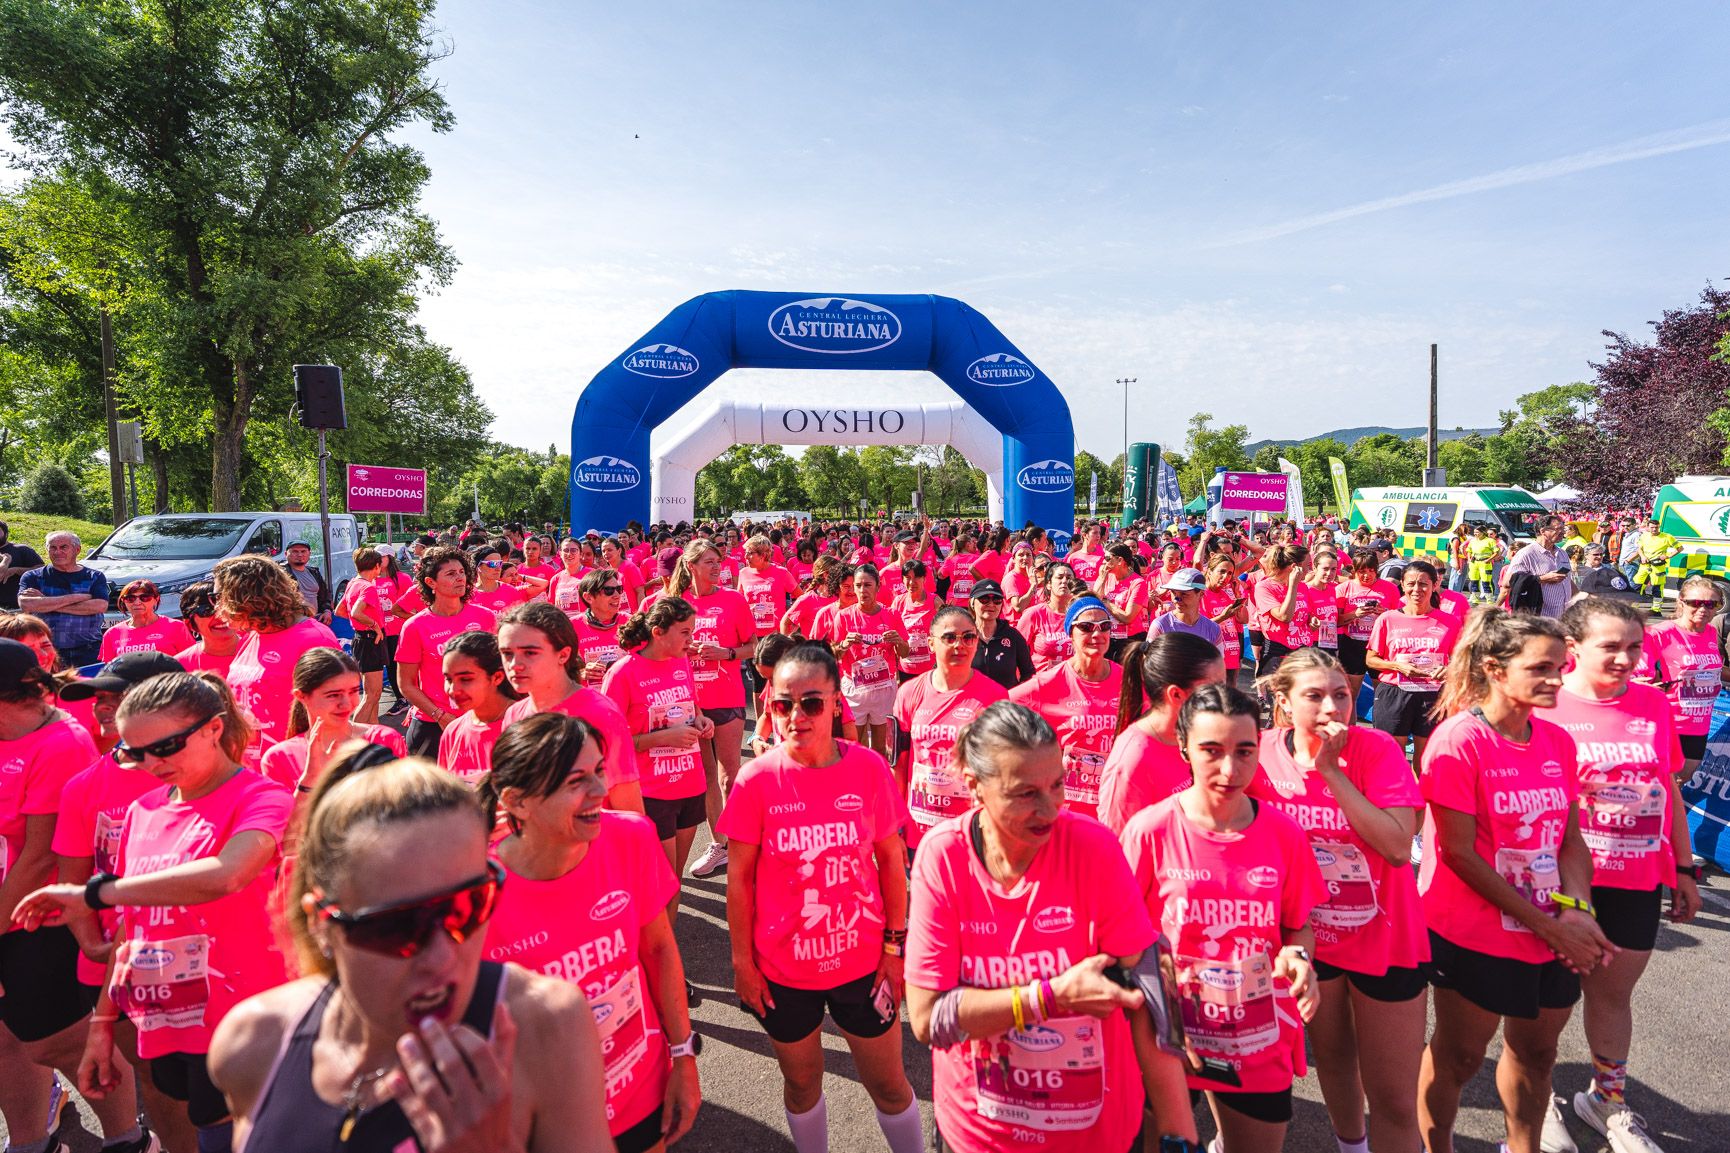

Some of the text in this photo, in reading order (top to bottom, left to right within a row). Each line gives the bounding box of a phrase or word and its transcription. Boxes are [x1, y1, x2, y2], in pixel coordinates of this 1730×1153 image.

[799, 312, 888, 321] CENTRAL LECHERA
[778, 312, 892, 340] ASTURIANA
[627, 355, 695, 372] ASTURIANA
[972, 365, 1031, 379] ASTURIANA
[782, 408, 904, 433] OYSHO
[394, 474, 422, 482] OYSHO
[577, 468, 637, 484] ASTURIANA
[1021, 472, 1073, 485] ASTURIANA
[350, 486, 422, 499] CORREDORAS
[654, 496, 687, 505] OYSHO
[1223, 489, 1286, 500] CORREDORAS
[1382, 492, 1449, 500] AMBULANCIA
[1395, 637, 1440, 649] CARRERA
[646, 684, 692, 706] CARRERA
[1696, 685, 1715, 694] 016
[1071, 714, 1118, 731] CARRER
[1563, 722, 1600, 732] YSHO
[1576, 741, 1665, 764] ARRERA
[653, 754, 696, 777] MUJER
[769, 801, 806, 815] OYSHO
[927, 794, 952, 807] 016
[1493, 786, 1569, 815] CARRERA
[1596, 811, 1638, 827] 016
[777, 820, 860, 854] CARRERA
[1166, 868, 1211, 881] OYSHO
[1176, 898, 1275, 927] CARRERA
[490, 931, 549, 960] OYSHO
[793, 929, 859, 961] MUJER
[818, 957, 841, 973] 2026
[960, 946, 1073, 989] CARRERA
[133, 984, 173, 1002] 016
[1012, 1067, 1064, 1090] 016
[1012, 1128, 1046, 1144] 2026
